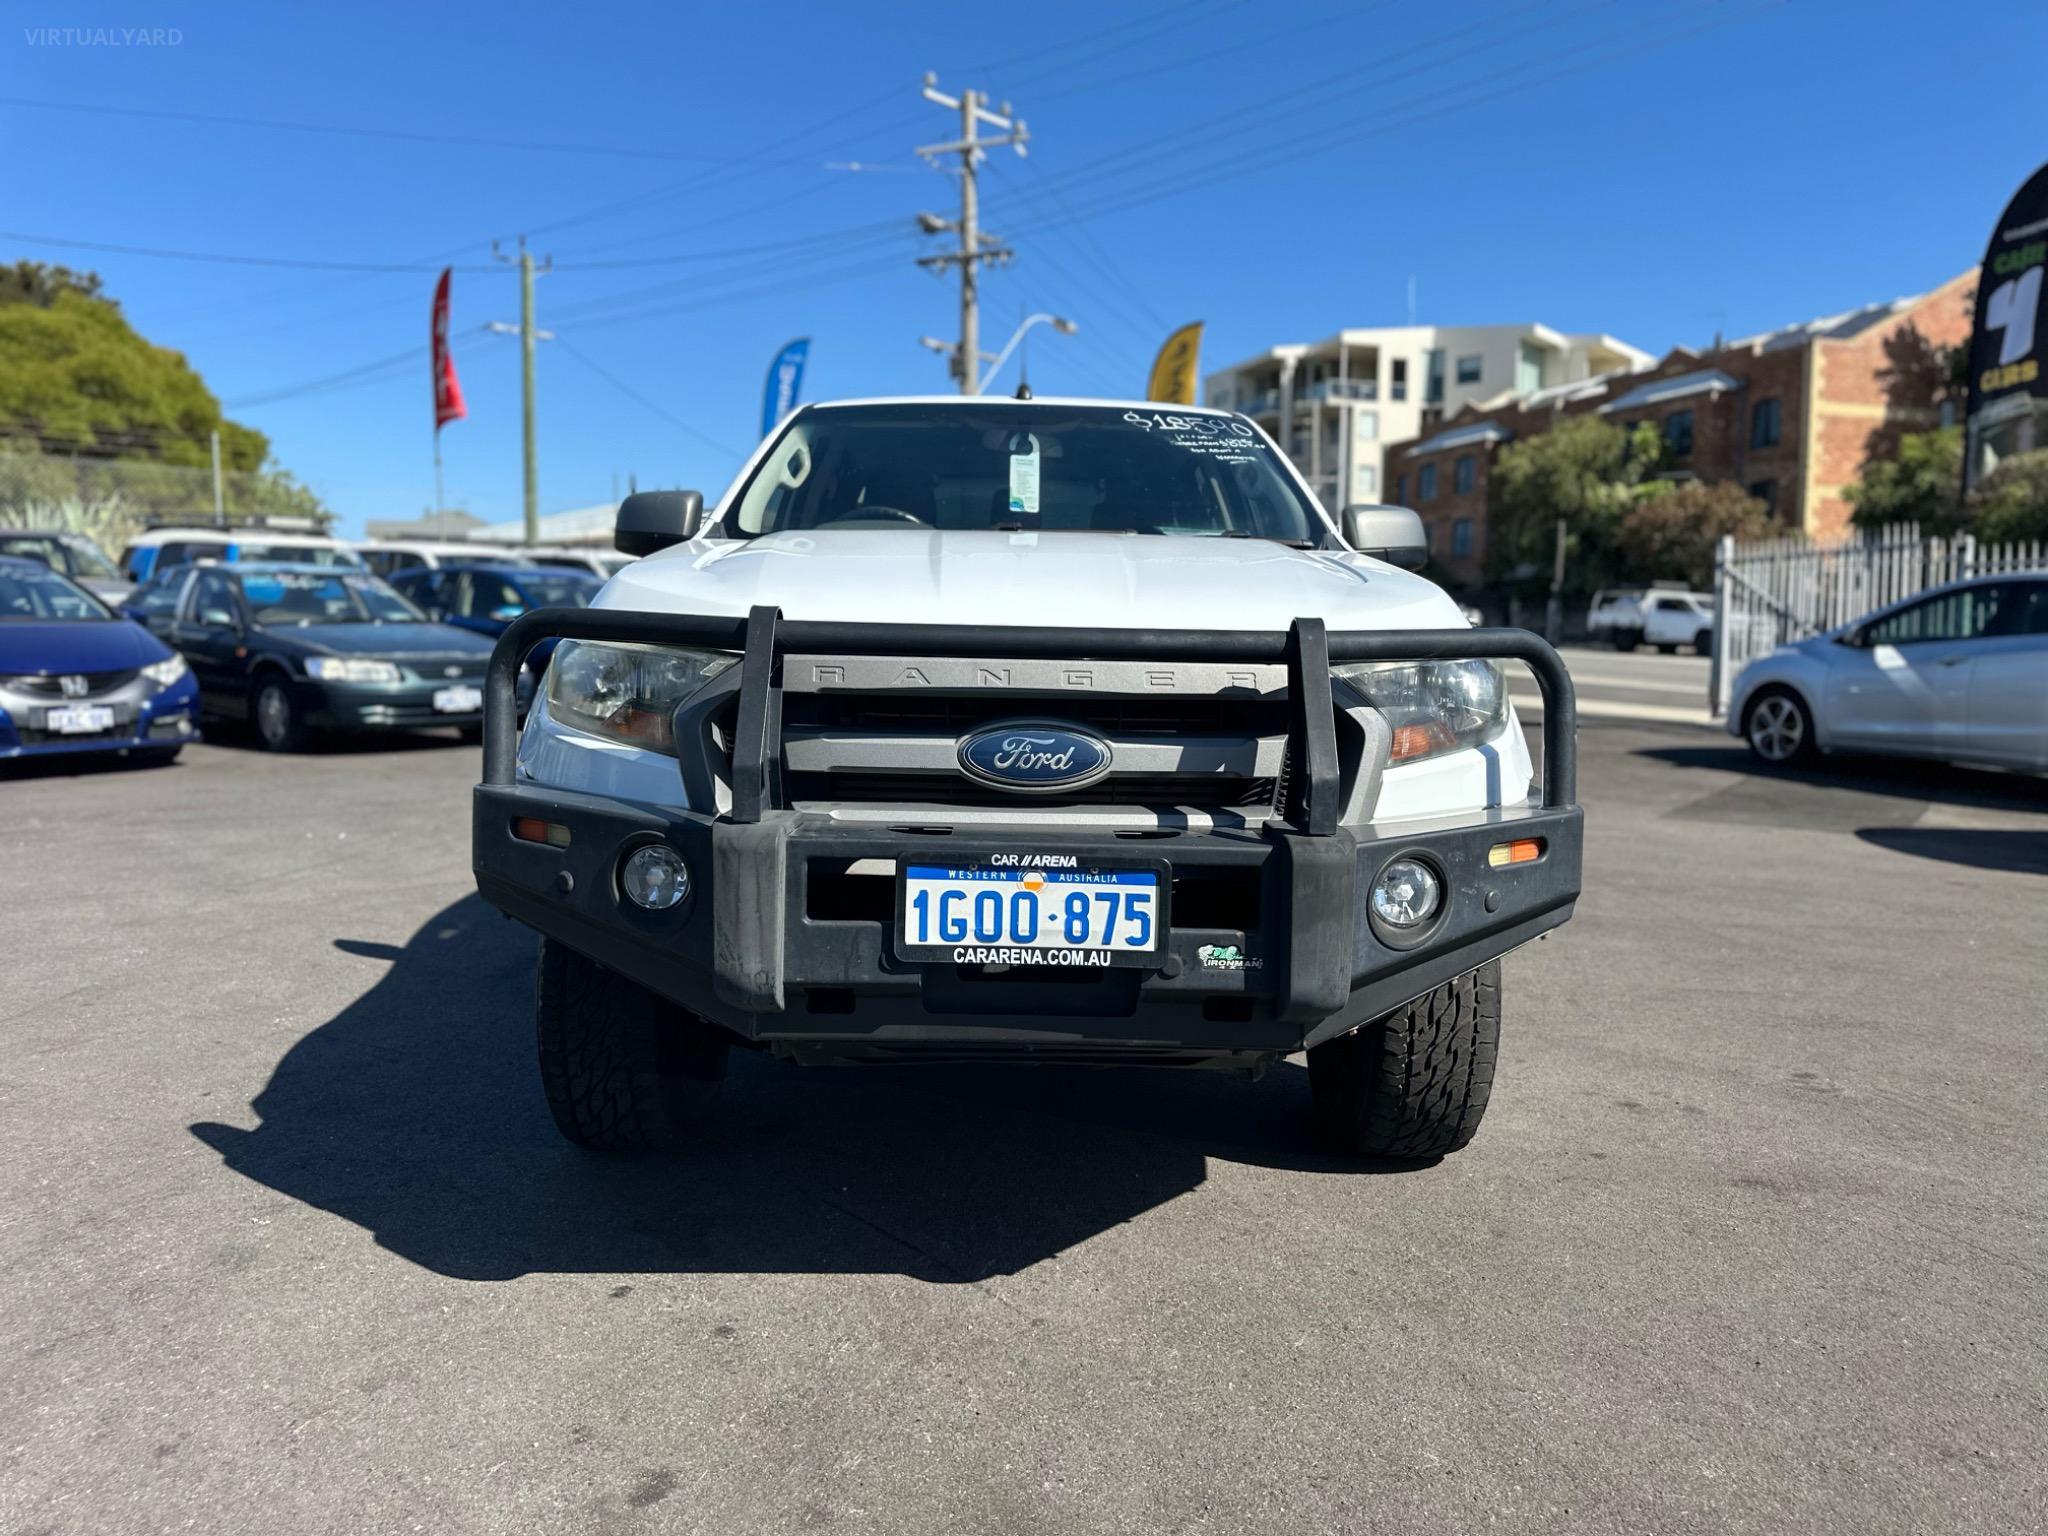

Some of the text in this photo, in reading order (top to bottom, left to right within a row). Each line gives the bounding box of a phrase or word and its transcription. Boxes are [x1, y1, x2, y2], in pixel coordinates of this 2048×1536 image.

[813, 665, 1257, 688] RANGER
[994, 736, 1073, 772] Ford
[991, 854, 1019, 867] CAR
[948, 870, 1118, 884] WESTERN AUSTRALIA
[953, 947, 1112, 967] CARARENA.COM.AU
